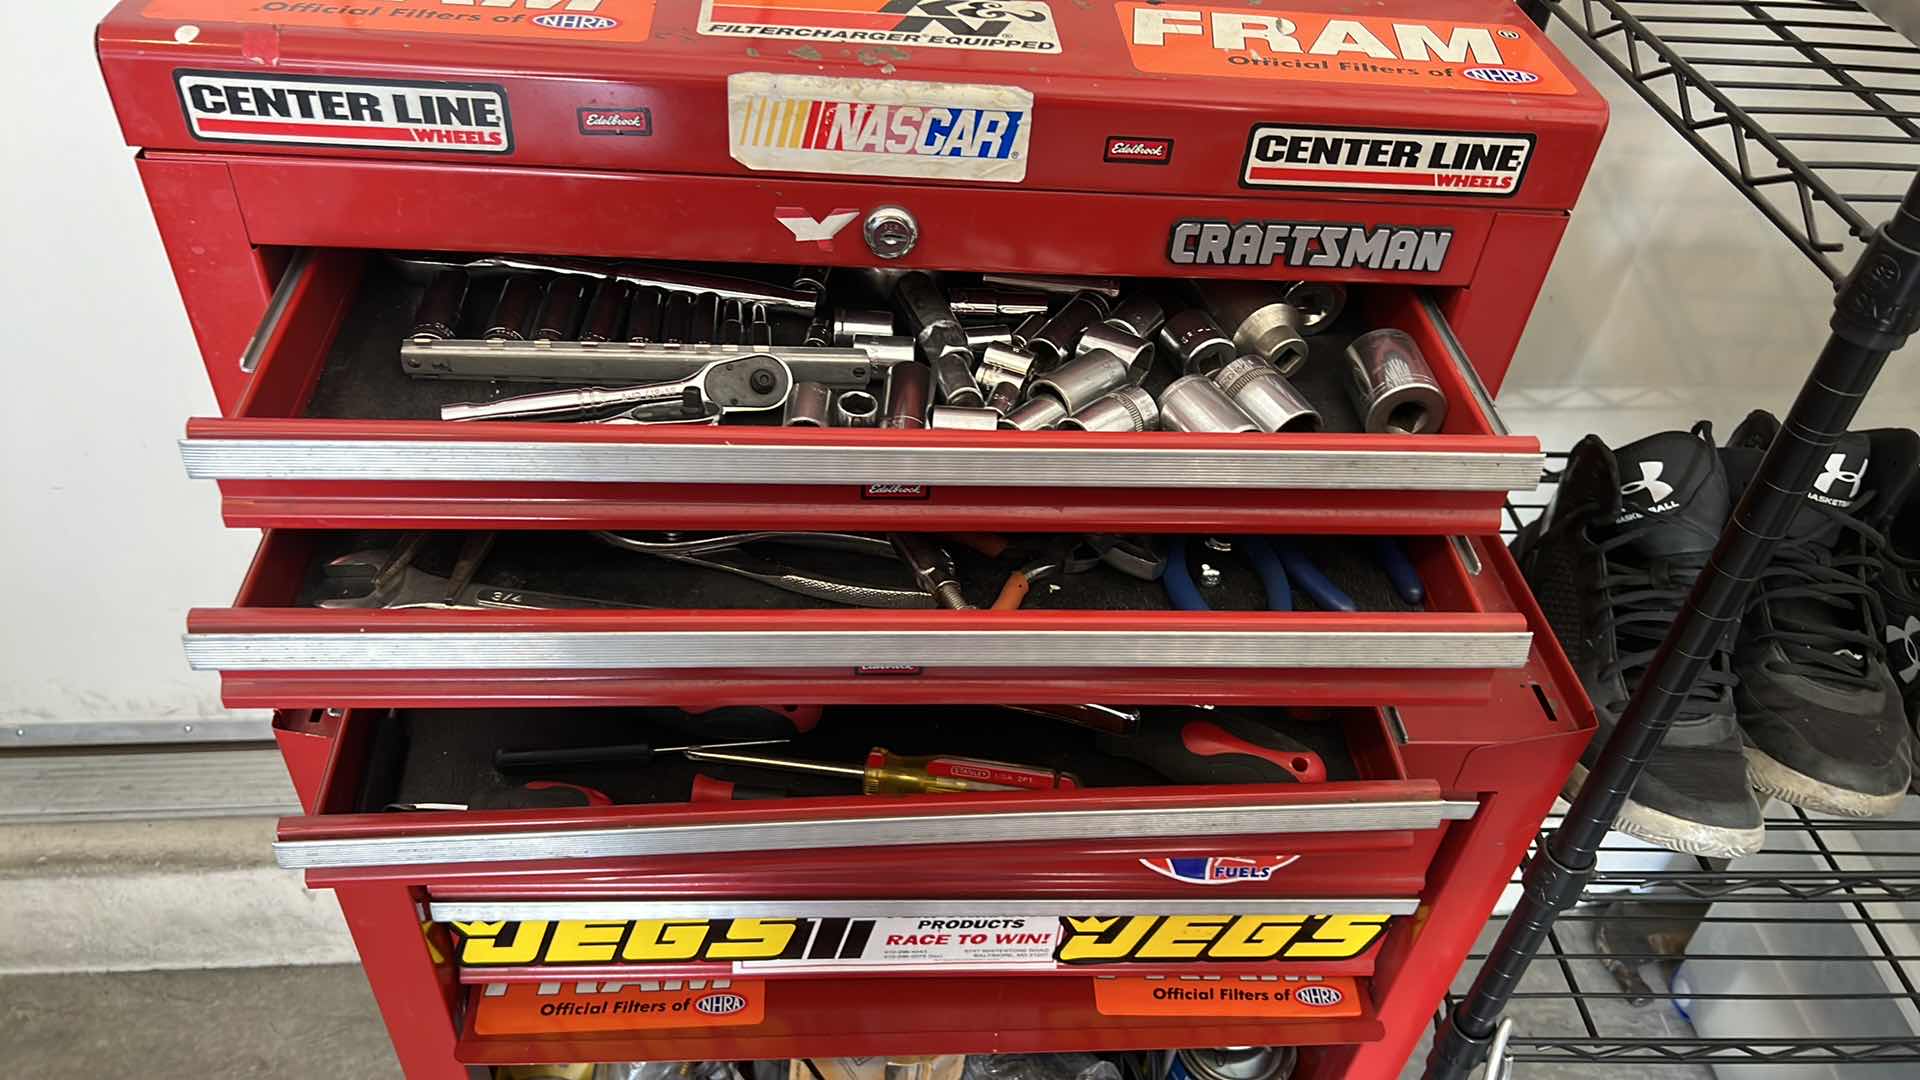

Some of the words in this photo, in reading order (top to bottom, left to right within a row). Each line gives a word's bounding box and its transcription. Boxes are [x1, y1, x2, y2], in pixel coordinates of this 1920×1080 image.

[389, 6, 481, 22] Filters
[492, 14, 525, 24] of
[537, 15, 613, 30] NHRA
[707, 23, 921, 43] FILTERCHARGER
[928, 35, 1055, 50] EQUIPPED
[1132, 8, 1504, 65] FRAM
[1227, 54, 1330, 71] Official
[1338, 61, 1420, 76] Filters
[1429, 67, 1455, 78] of
[1467, 68, 1536, 84] NHRA
[187, 83, 382, 122] CENTER
[393, 93, 501, 128] LINE
[586, 114, 640, 126] Edelbrock
[826, 103, 1010, 159] NASCAR
[411, 127, 502, 146] WHEELS
[1111, 142, 1163, 155] Edelbrock
[1255, 134, 1422, 169] CENTER
[1427, 142, 1525, 172] LINE
[1436, 173, 1514, 189] WHEELS
[1169, 221, 1454, 272] CRAFTSMAN
[1214, 867, 1271, 878] FUELS
[918, 919, 1025, 930] PRODUCTS
[886, 934, 951, 945] RACE
[959, 934, 988, 945] TO
[995, 933, 1052, 945] WIN!
[540, 1001, 606, 1017] Official
[613, 999, 667, 1015] Filters
[671, 997, 692, 1011] of
[700, 994, 744, 1013] NHRA
[1152, 987, 1214, 1000] Official
[1219, 986, 1270, 1001] Filters
[1274, 986, 1292, 1001] of
[1298, 987, 1341, 1005] NHRA
